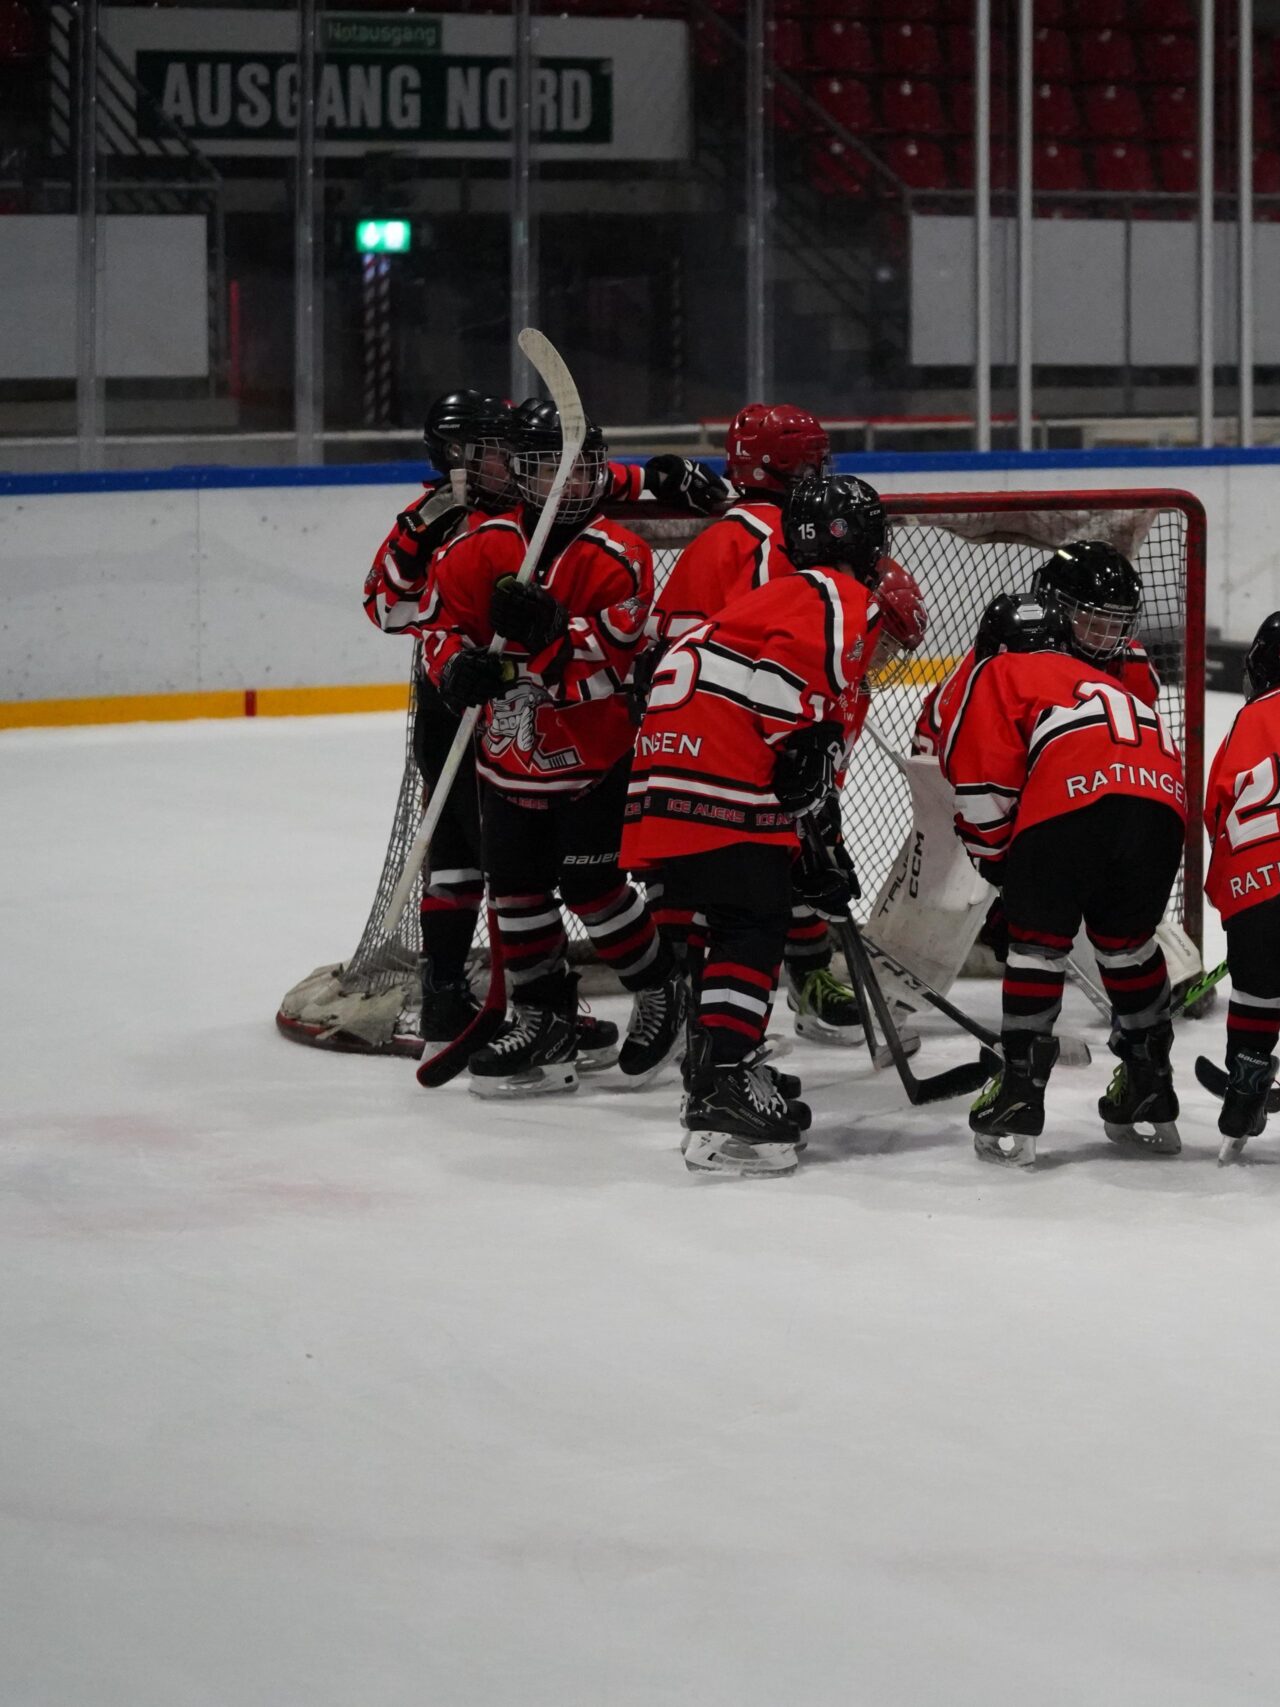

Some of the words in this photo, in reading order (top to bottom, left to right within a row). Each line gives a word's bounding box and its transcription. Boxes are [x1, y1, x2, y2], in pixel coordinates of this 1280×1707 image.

[161, 62, 421, 129] AUSGANG
[446, 66, 593, 132] NORD
[798, 523, 816, 540] 15
[909, 830, 926, 899] CCM
